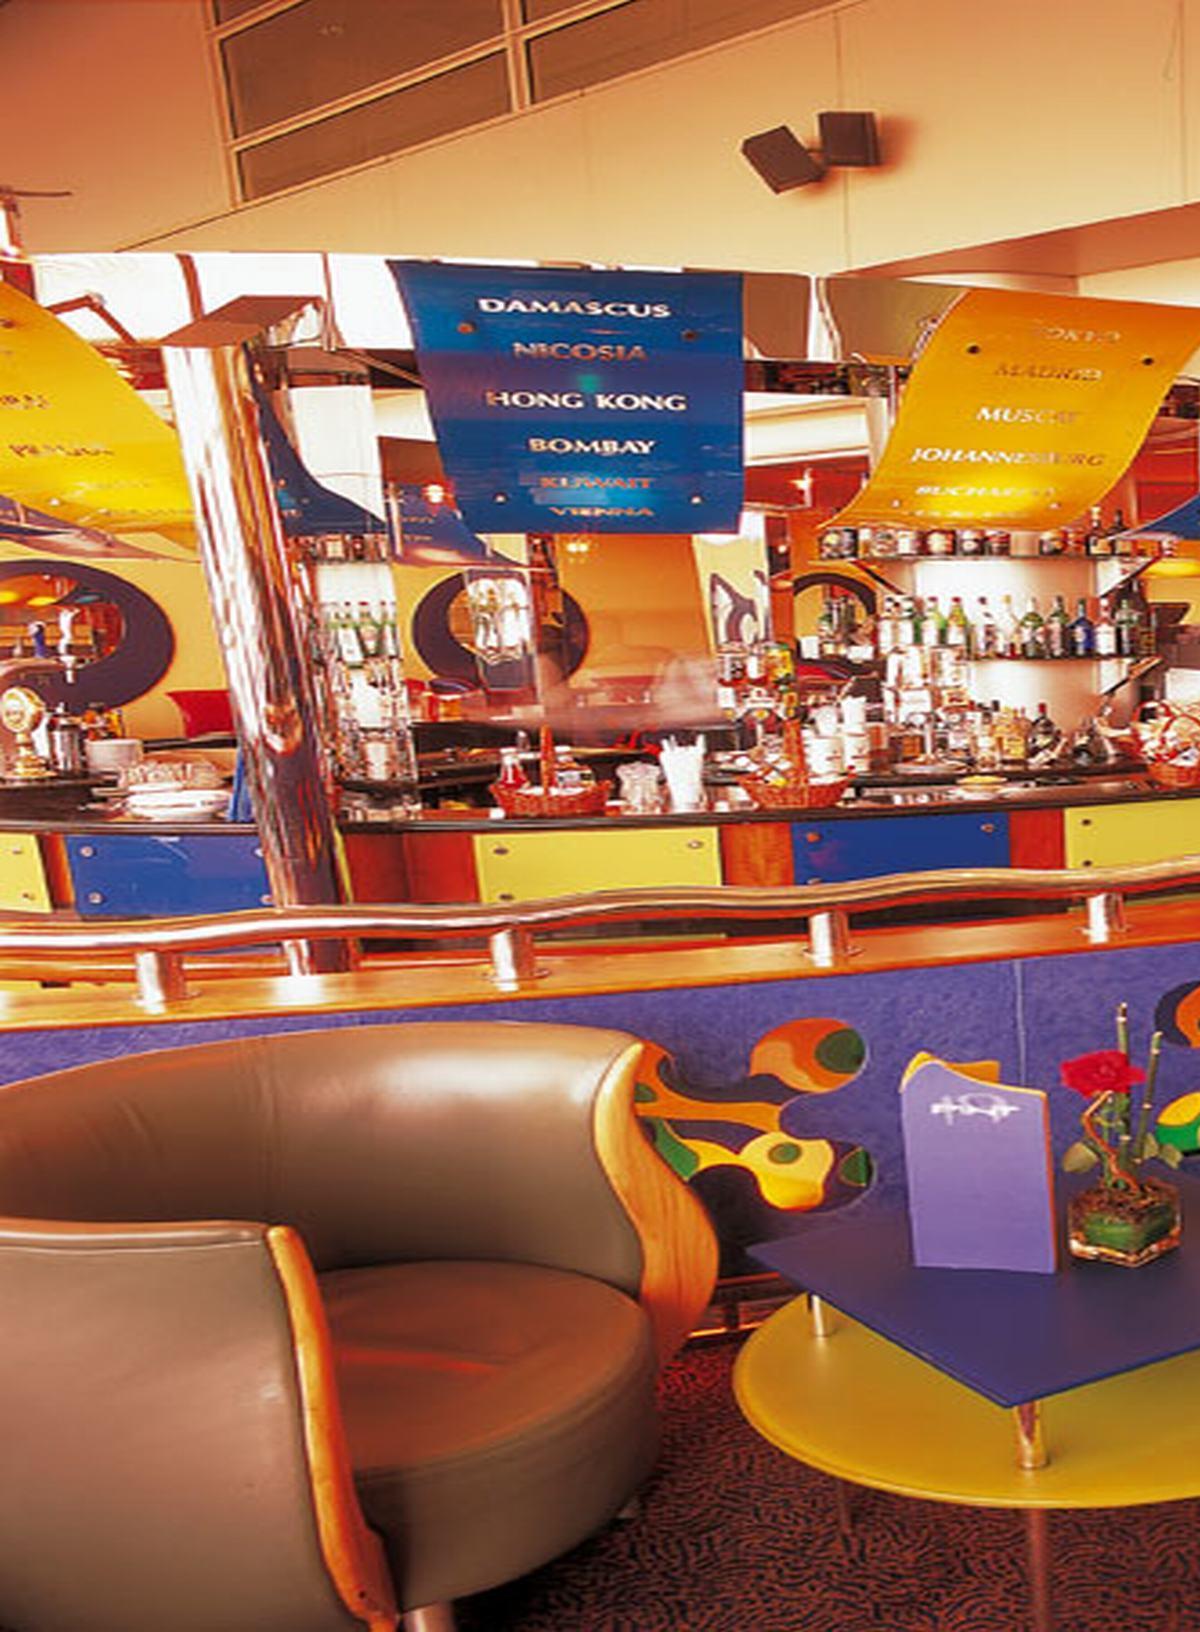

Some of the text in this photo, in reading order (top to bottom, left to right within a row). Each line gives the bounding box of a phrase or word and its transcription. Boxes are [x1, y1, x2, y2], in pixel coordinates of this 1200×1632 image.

[478, 299, 671, 318] DAMASCUS
[512, 341, 648, 361] NICOSIA
[486, 391, 687, 411] HONG KONG
[529, 437, 656, 456] BOMBAY
[540, 476, 654, 490] KUWAIT
[549, 506, 654, 517] VIENNA
